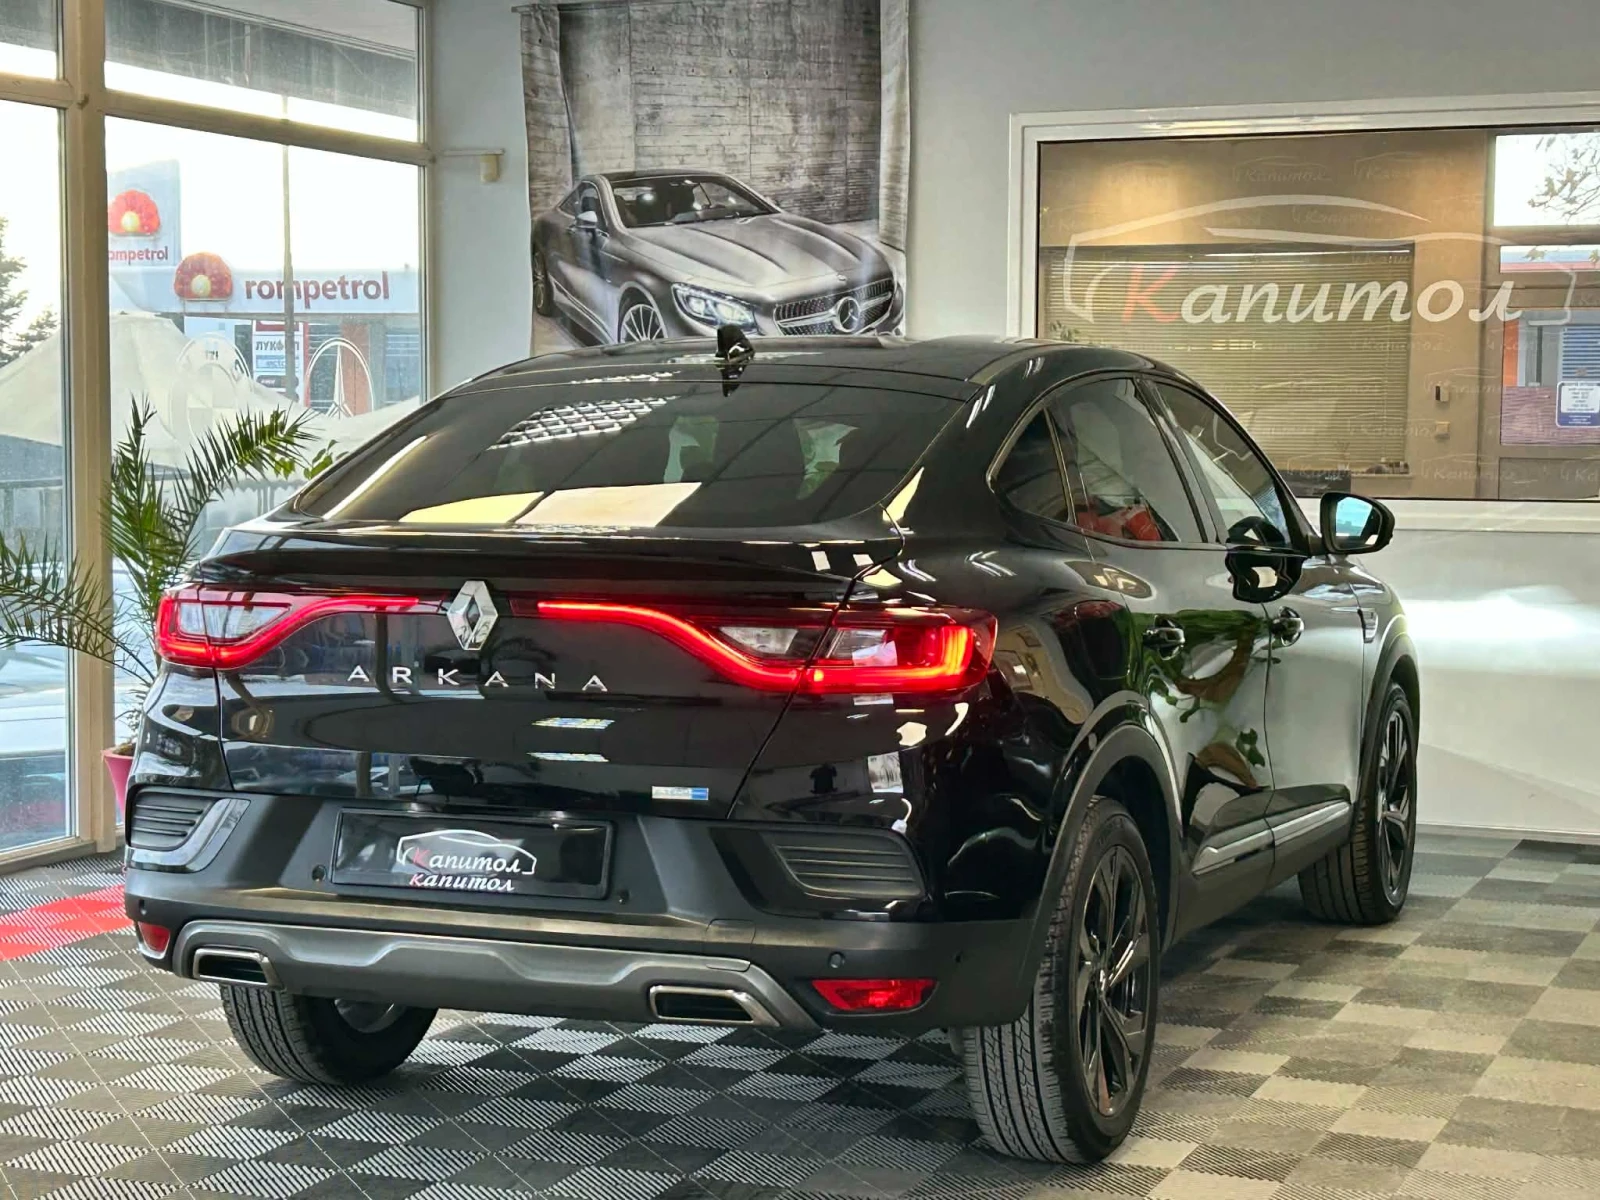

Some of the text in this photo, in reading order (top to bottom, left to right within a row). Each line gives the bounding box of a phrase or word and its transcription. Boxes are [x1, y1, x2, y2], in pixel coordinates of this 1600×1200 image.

[108, 246, 168, 265] ompetrol
[245, 271, 390, 309] rompetrol
[1121, 264, 1523, 324] Капитол
[347, 664, 608, 692] ARKANA
[412, 847, 521, 873] Капитол
